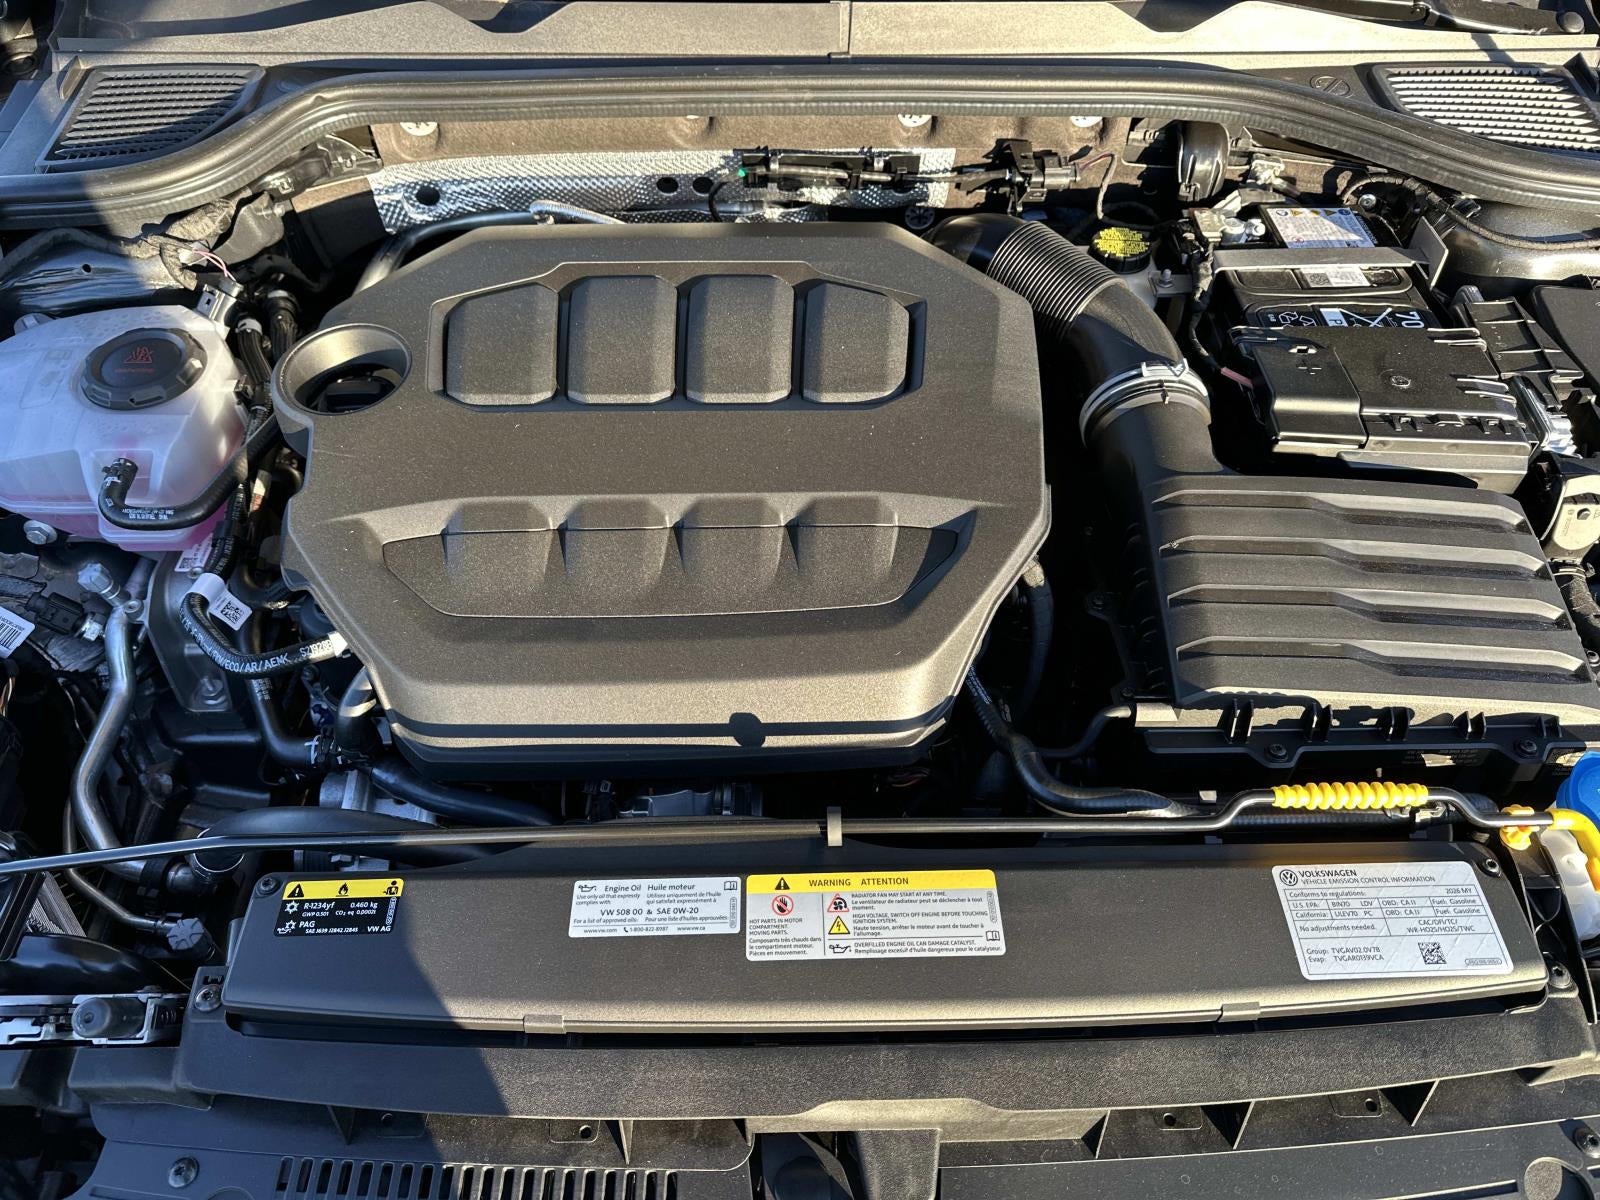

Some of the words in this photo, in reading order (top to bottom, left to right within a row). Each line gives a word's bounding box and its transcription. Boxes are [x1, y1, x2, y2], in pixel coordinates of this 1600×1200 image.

[809, 878, 851, 887] WARNING
[861, 878, 909, 886] ATTENTION
[304, 902, 336, 911] R-1234yf
